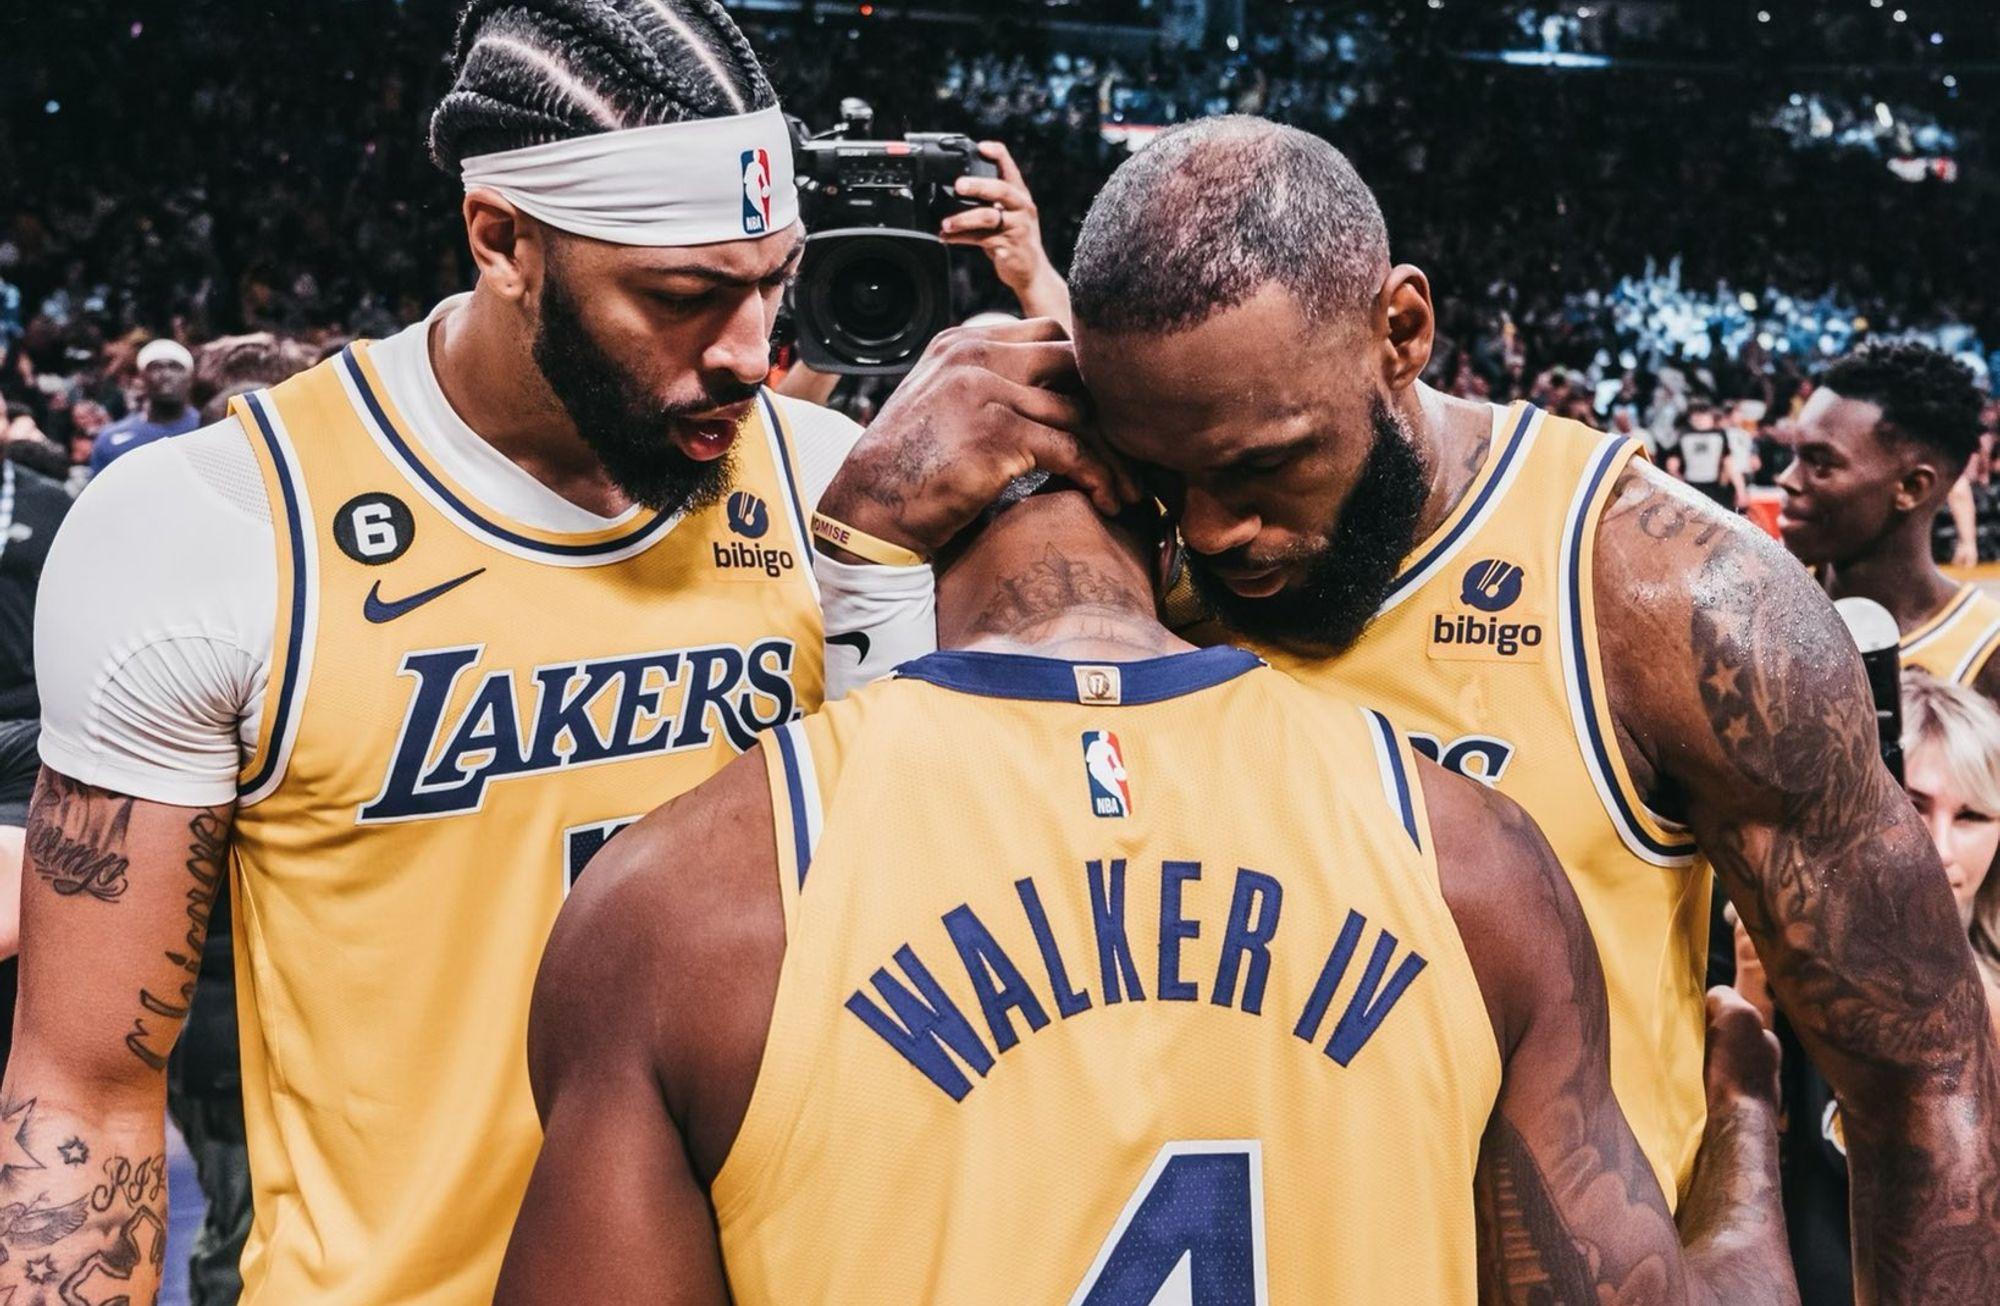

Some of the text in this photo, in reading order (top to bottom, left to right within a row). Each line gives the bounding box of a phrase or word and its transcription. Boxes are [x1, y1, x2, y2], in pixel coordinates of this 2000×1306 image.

[352, 502, 398, 556] 6
[713, 541, 794, 578] bibigo
[1434, 614, 1542, 656] bibigo
[355, 636, 797, 825] LAKERS
[1096, 797, 1120, 815] NBA
[844, 858, 1429, 1104] WALKER IV
[1066, 1138, 1270, 1306] 4
